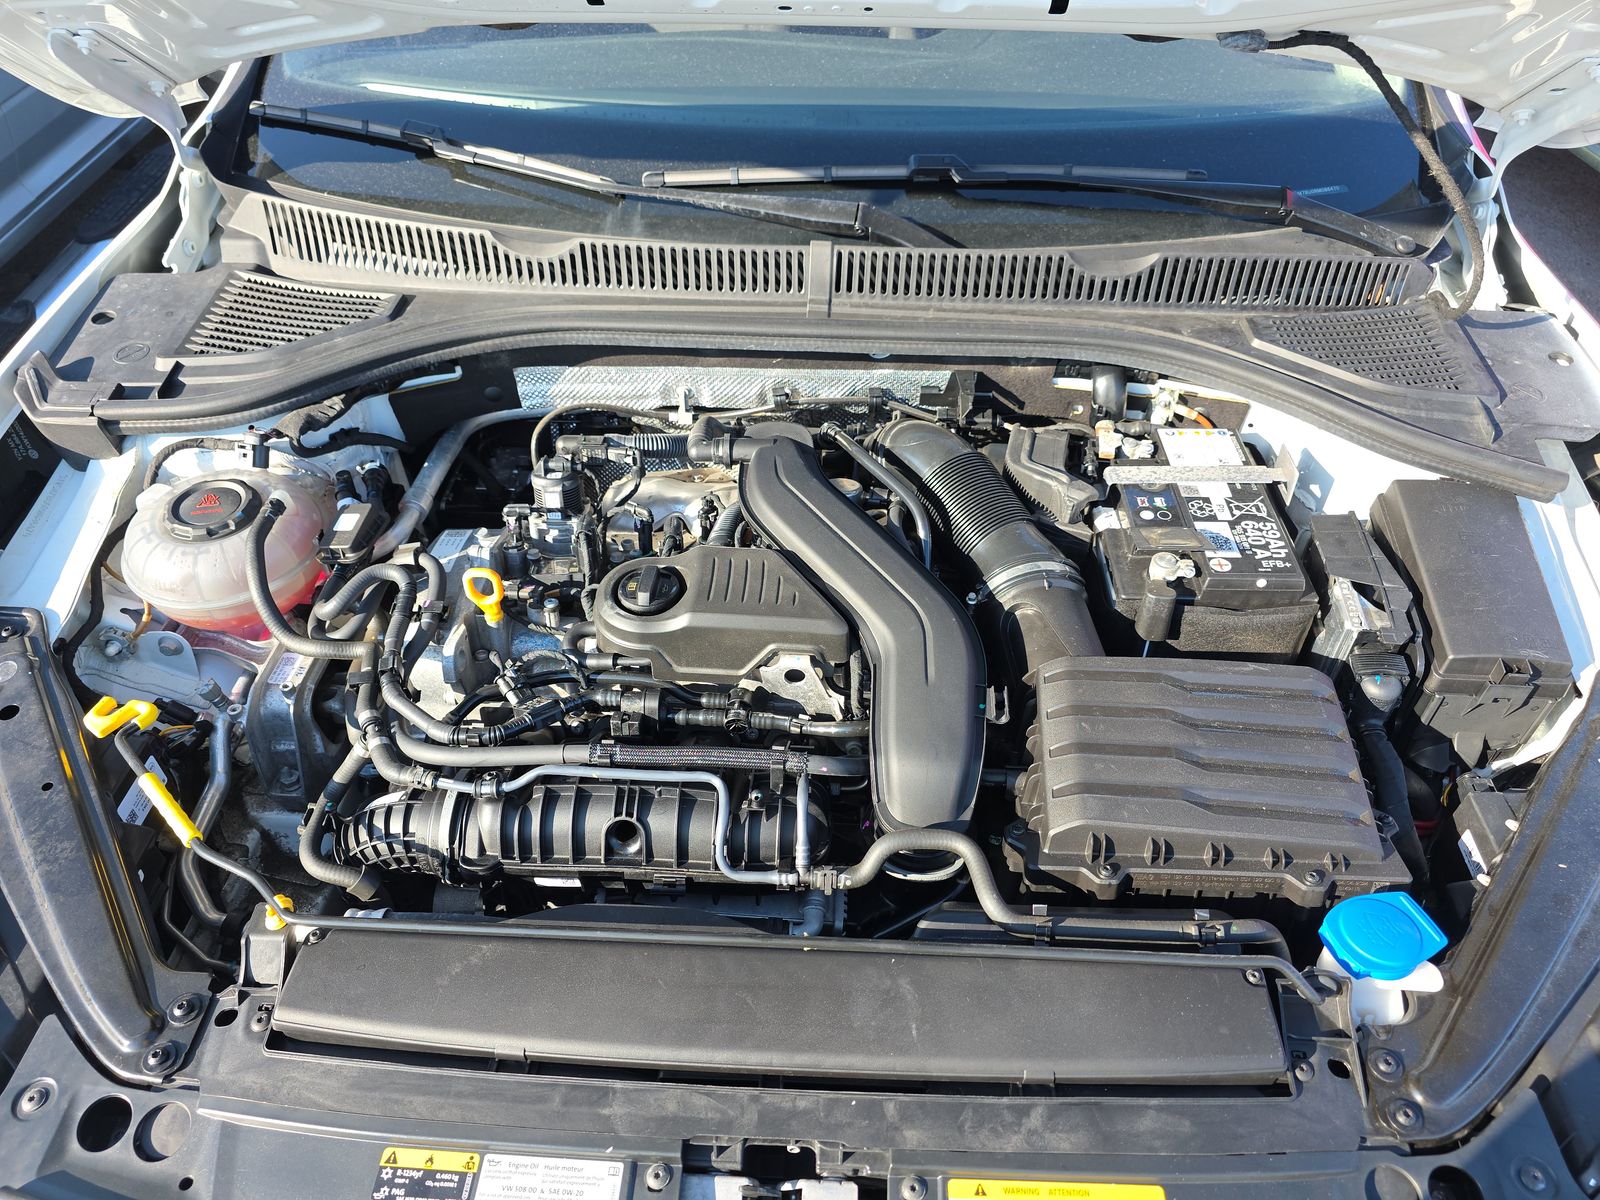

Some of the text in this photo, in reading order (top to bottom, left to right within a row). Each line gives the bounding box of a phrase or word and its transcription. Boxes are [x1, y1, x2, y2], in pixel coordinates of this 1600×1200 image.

[1240, 520, 1266, 545] 640
[1259, 521, 1288, 558] 59Ah
[1252, 548, 1272, 559] A
[1261, 560, 1292, 568] EFB+
[508, 1161, 529, 1170] Engine
[544, 1163, 560, 1171] Huile
[390, 1188, 406, 1196] PAG
[1003, 1187, 1090, 1197] WARNING ATTENTION
